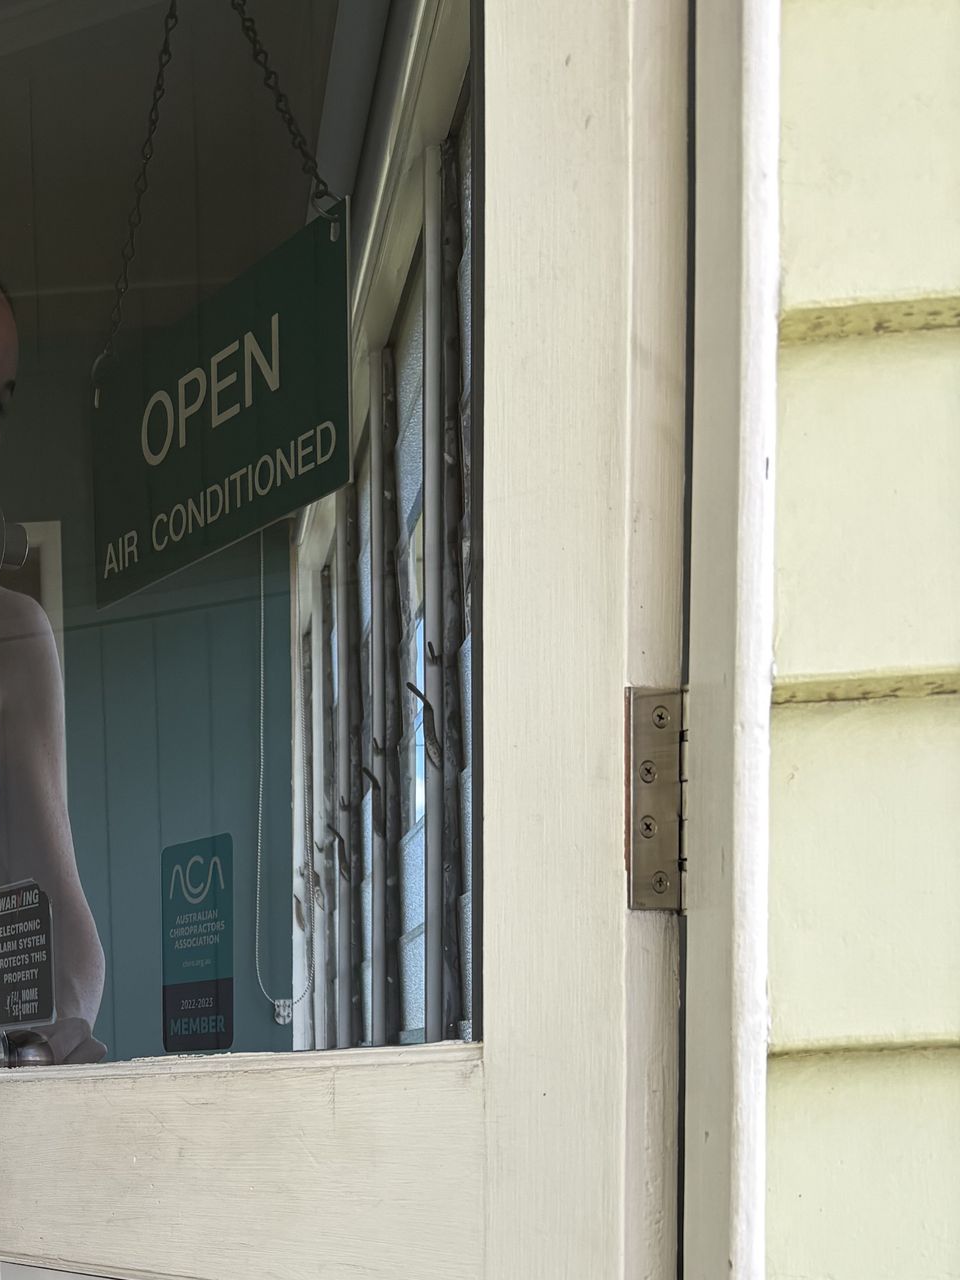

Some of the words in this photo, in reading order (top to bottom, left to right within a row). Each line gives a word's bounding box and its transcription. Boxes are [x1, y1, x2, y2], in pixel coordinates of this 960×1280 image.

[141, 312, 280, 466] OPEN
[103, 530, 139, 579] AIR
[152, 420, 337, 551] CONDITIONED
[175, 909, 218, 925] AUSTRALIAN
[169, 920, 225, 938] CHIROPRACTORS
[18, 933, 46, 950] SYSTEM
[174, 933, 220, 950] ASSOCIATION
[30, 950, 47, 963] THIS
[3, 967, 39, 984] PROPERTY
[21, 987, 39, 1001] HOME
[180, 997, 214, 1010] 2022-2023
[169, 1015, 226, 1036] MEMBER
